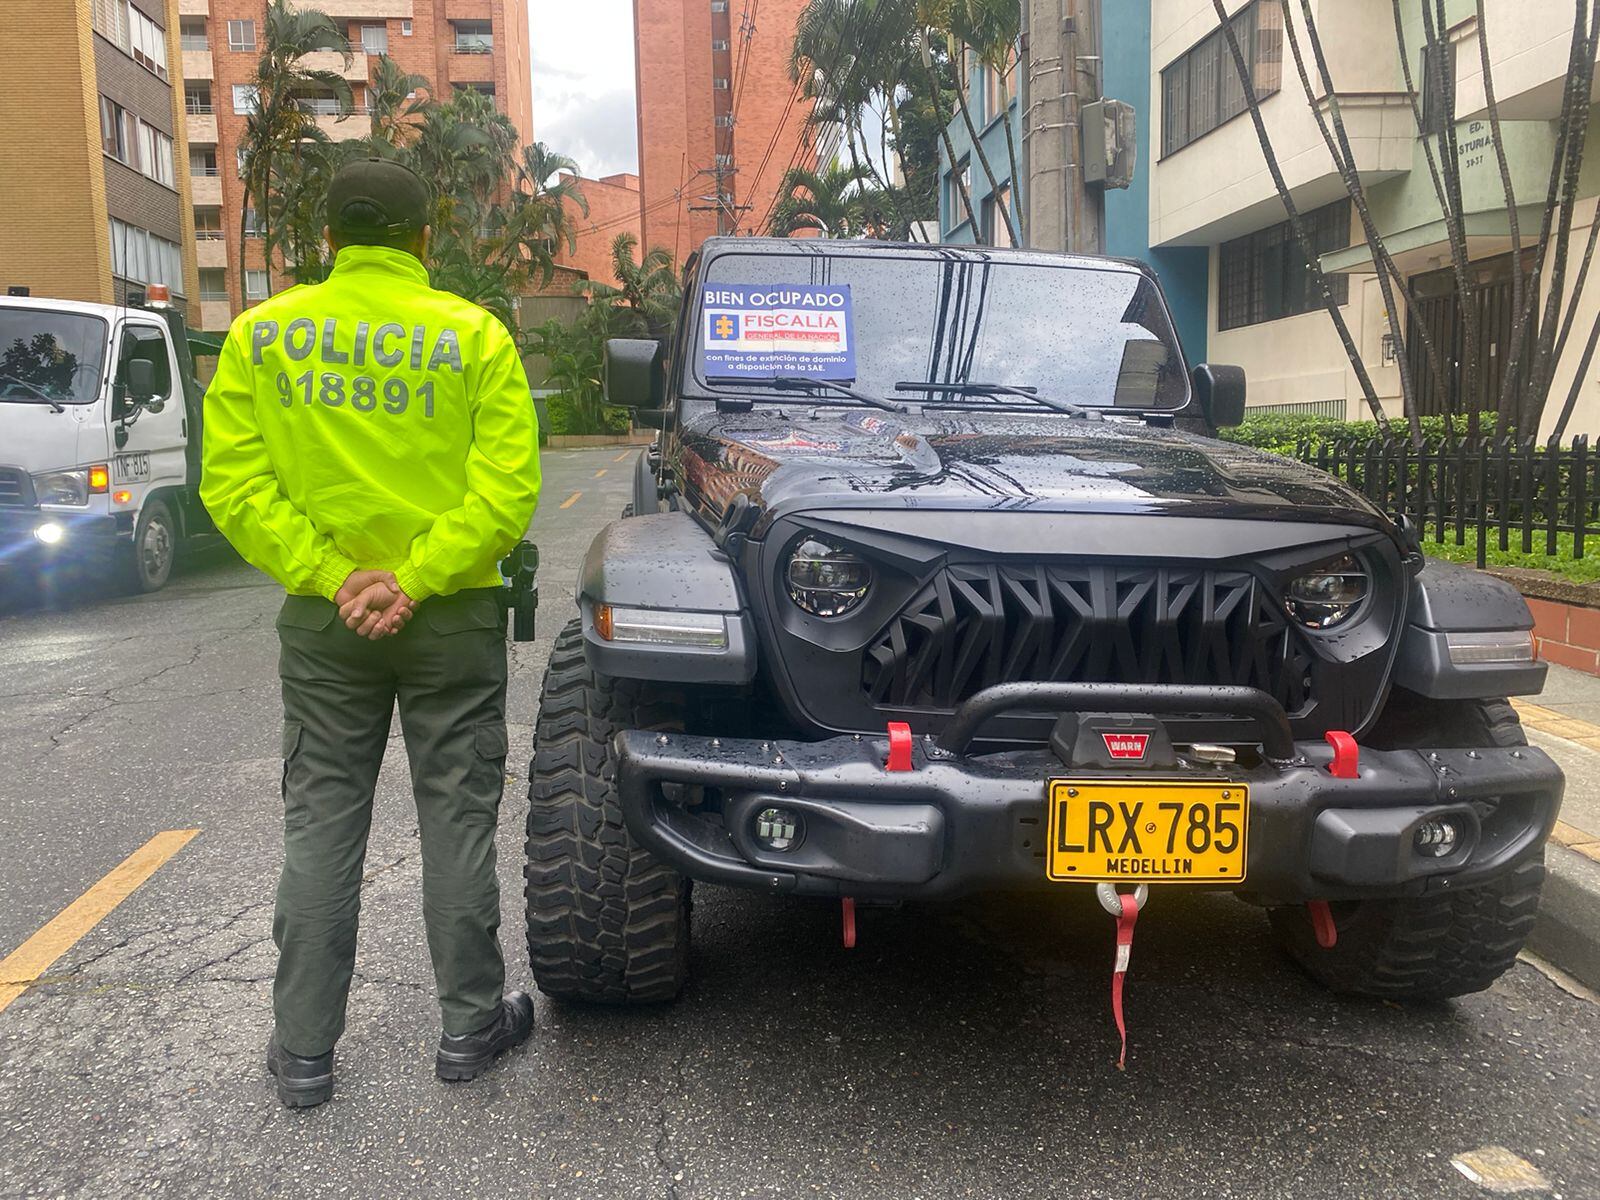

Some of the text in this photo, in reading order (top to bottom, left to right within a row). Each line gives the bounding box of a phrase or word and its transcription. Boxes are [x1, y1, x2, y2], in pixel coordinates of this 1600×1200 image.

[1469, 122, 1485, 135] ED.
[705, 291, 845, 307] BIEN OCUPADO
[744, 313, 838, 328] FISCALÍA
[252, 317, 464, 373] POLICIA
[807, 364, 826, 372] SAE.
[276, 370, 434, 418] 918891
[1110, 741, 1142, 751] WARN
[1057, 801, 1240, 854] LRX 785
[1107, 858, 1192, 874] MEDELLIN
